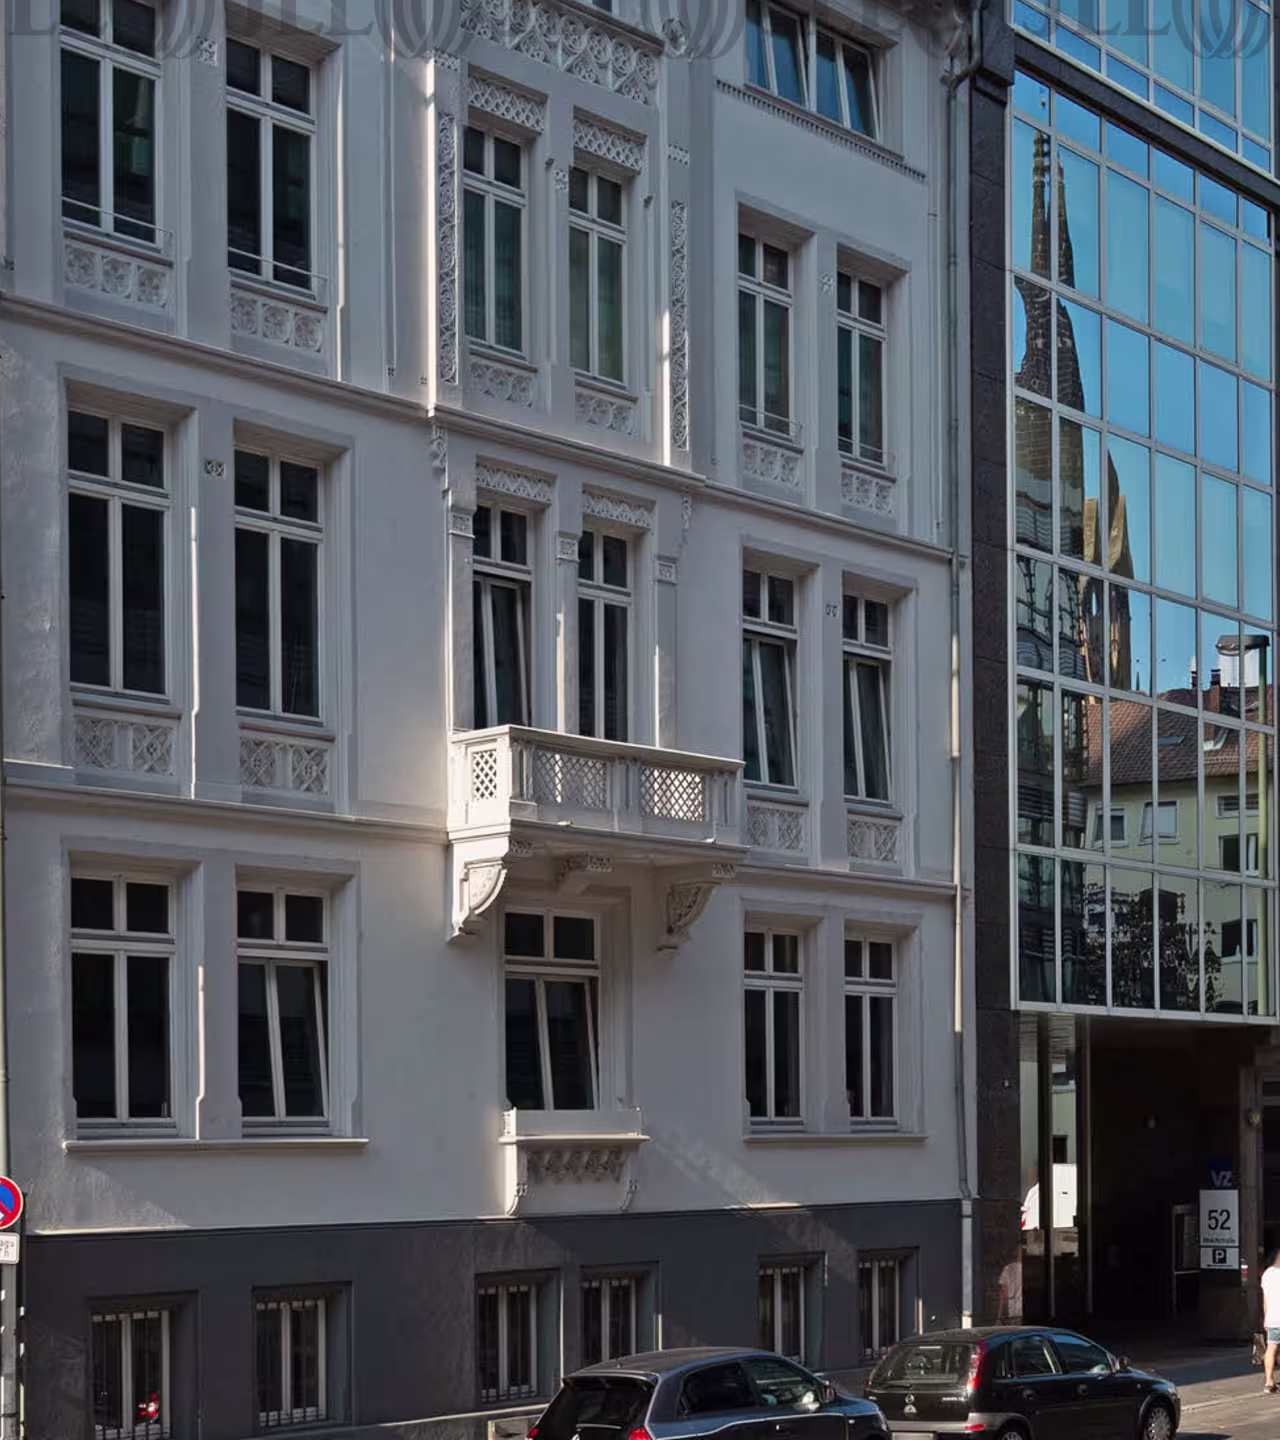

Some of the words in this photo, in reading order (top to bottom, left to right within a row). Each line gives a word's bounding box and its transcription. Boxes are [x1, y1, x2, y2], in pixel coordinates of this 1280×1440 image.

[1210, 1169, 1232, 1187] VZ
[1208, 1209, 1231, 1230] 52
[1215, 1249, 1225, 1262] P
